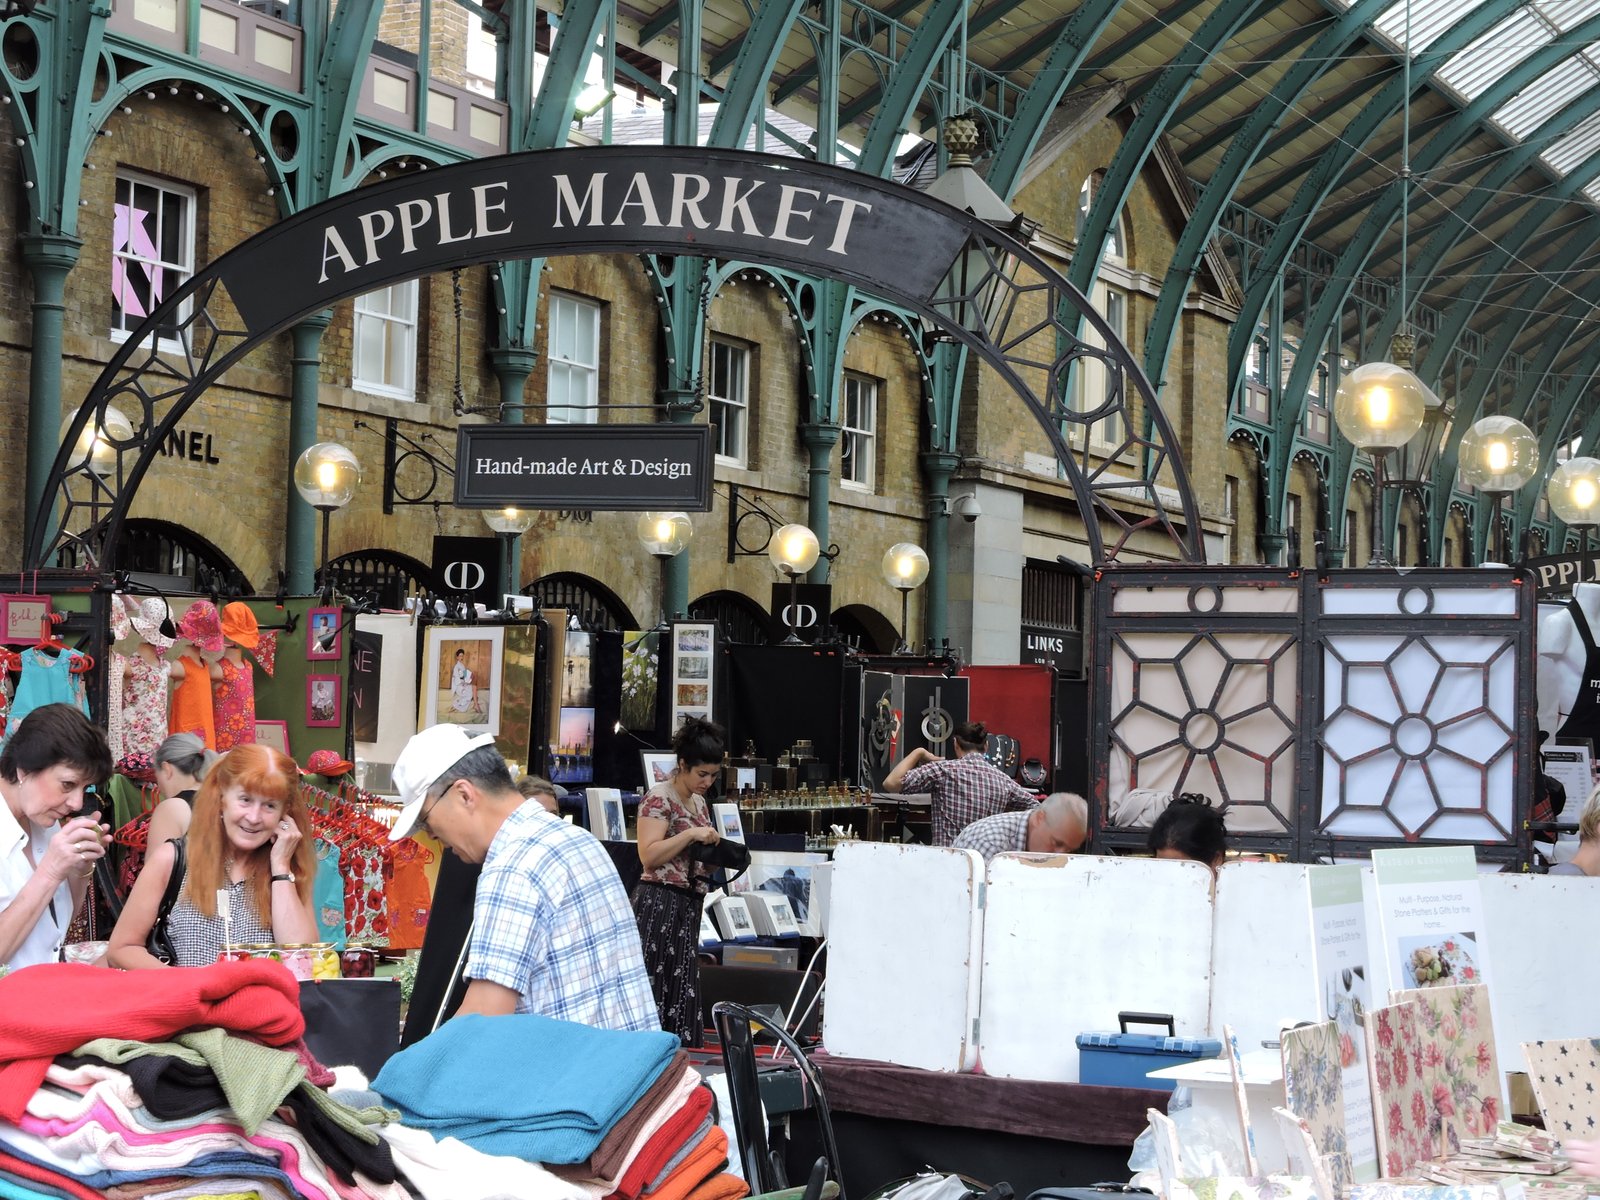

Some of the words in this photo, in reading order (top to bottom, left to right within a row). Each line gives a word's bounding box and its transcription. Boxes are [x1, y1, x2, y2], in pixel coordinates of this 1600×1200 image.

[318, 181, 514, 285] APPLE
[552, 172, 873, 256] MARKET
[475, 457, 577, 475] Hand-made
[579, 458, 609, 475] Art
[612, 459, 627, 475] &
[629, 458, 692, 480] Design
[1027, 634, 1064, 654] LINKS
